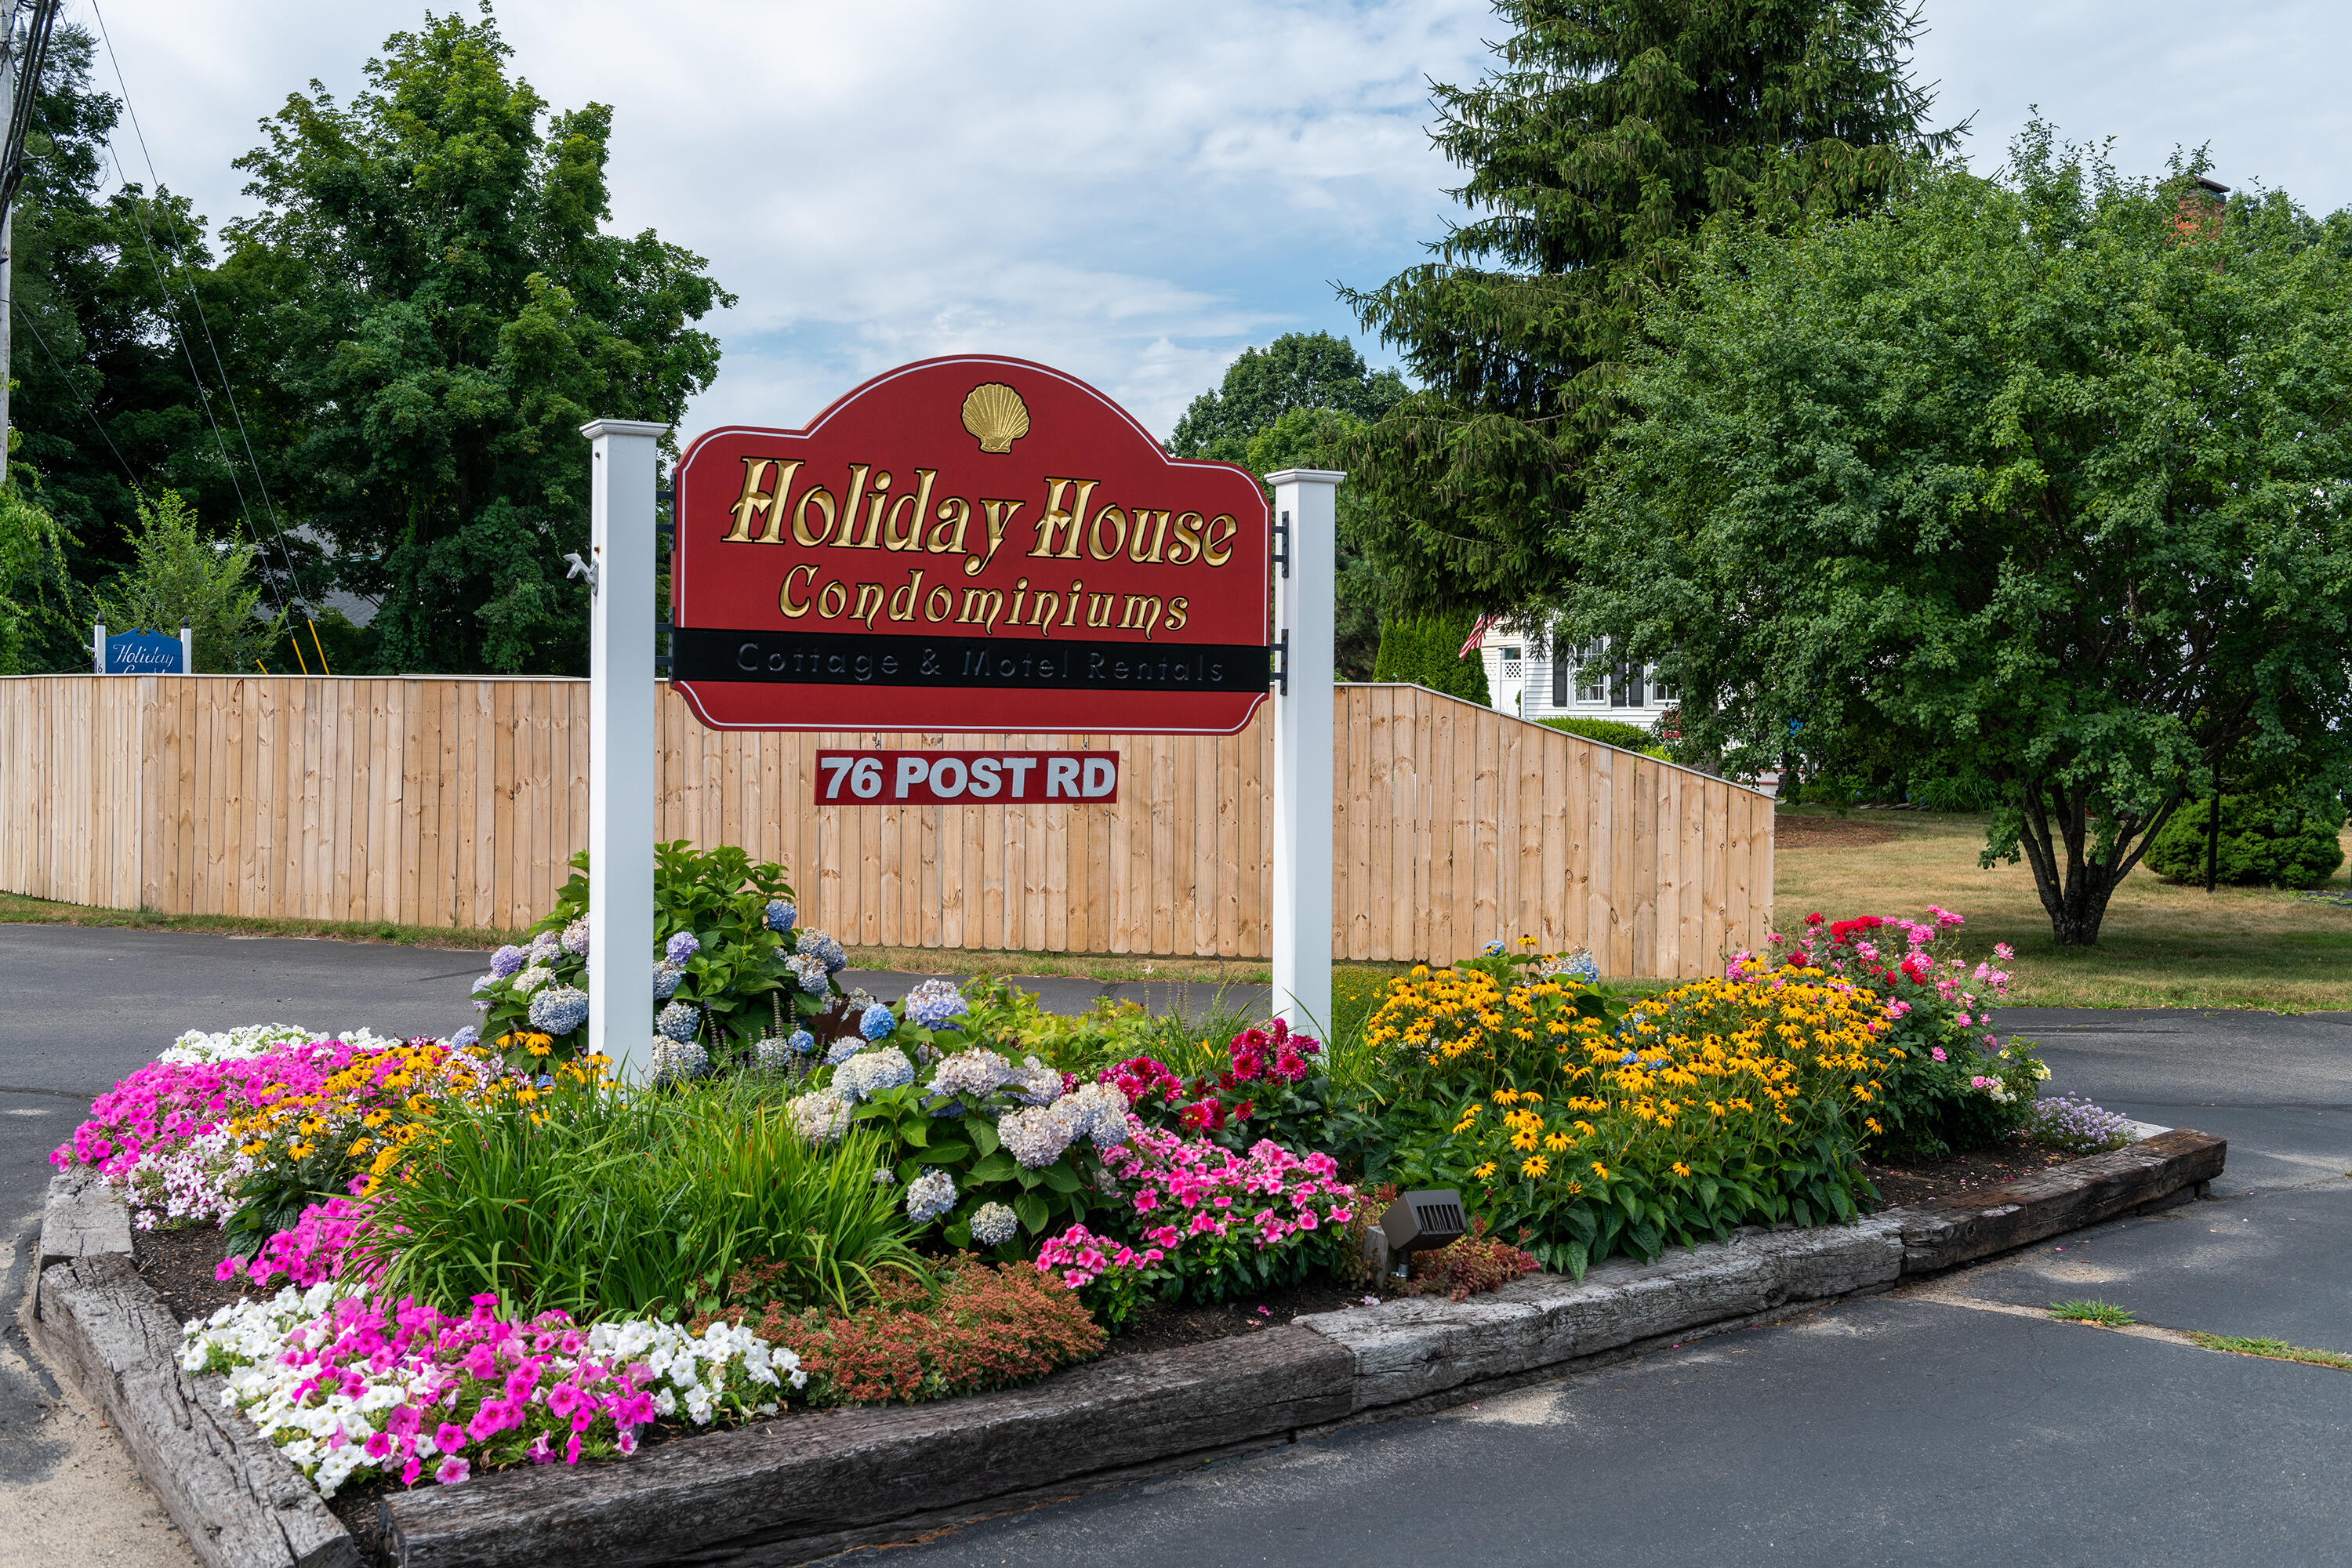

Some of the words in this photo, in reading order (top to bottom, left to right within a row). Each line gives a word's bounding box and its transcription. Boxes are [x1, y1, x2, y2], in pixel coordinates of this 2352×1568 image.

[720, 457, 1024, 577] Holiday
[1027, 476, 1239, 568] House
[779, 564, 1189, 640] Condominiums
[113, 643, 174, 667] Holiday
[735, 643, 899, 681] Cottage
[919, 648, 941, 675] &
[961, 648, 1069, 677] Motel
[1088, 652, 1223, 681] Rentals
[820, 757, 883, 799] 76
[895, 757, 1036, 799] POST
[1047, 758, 1116, 797] RD
